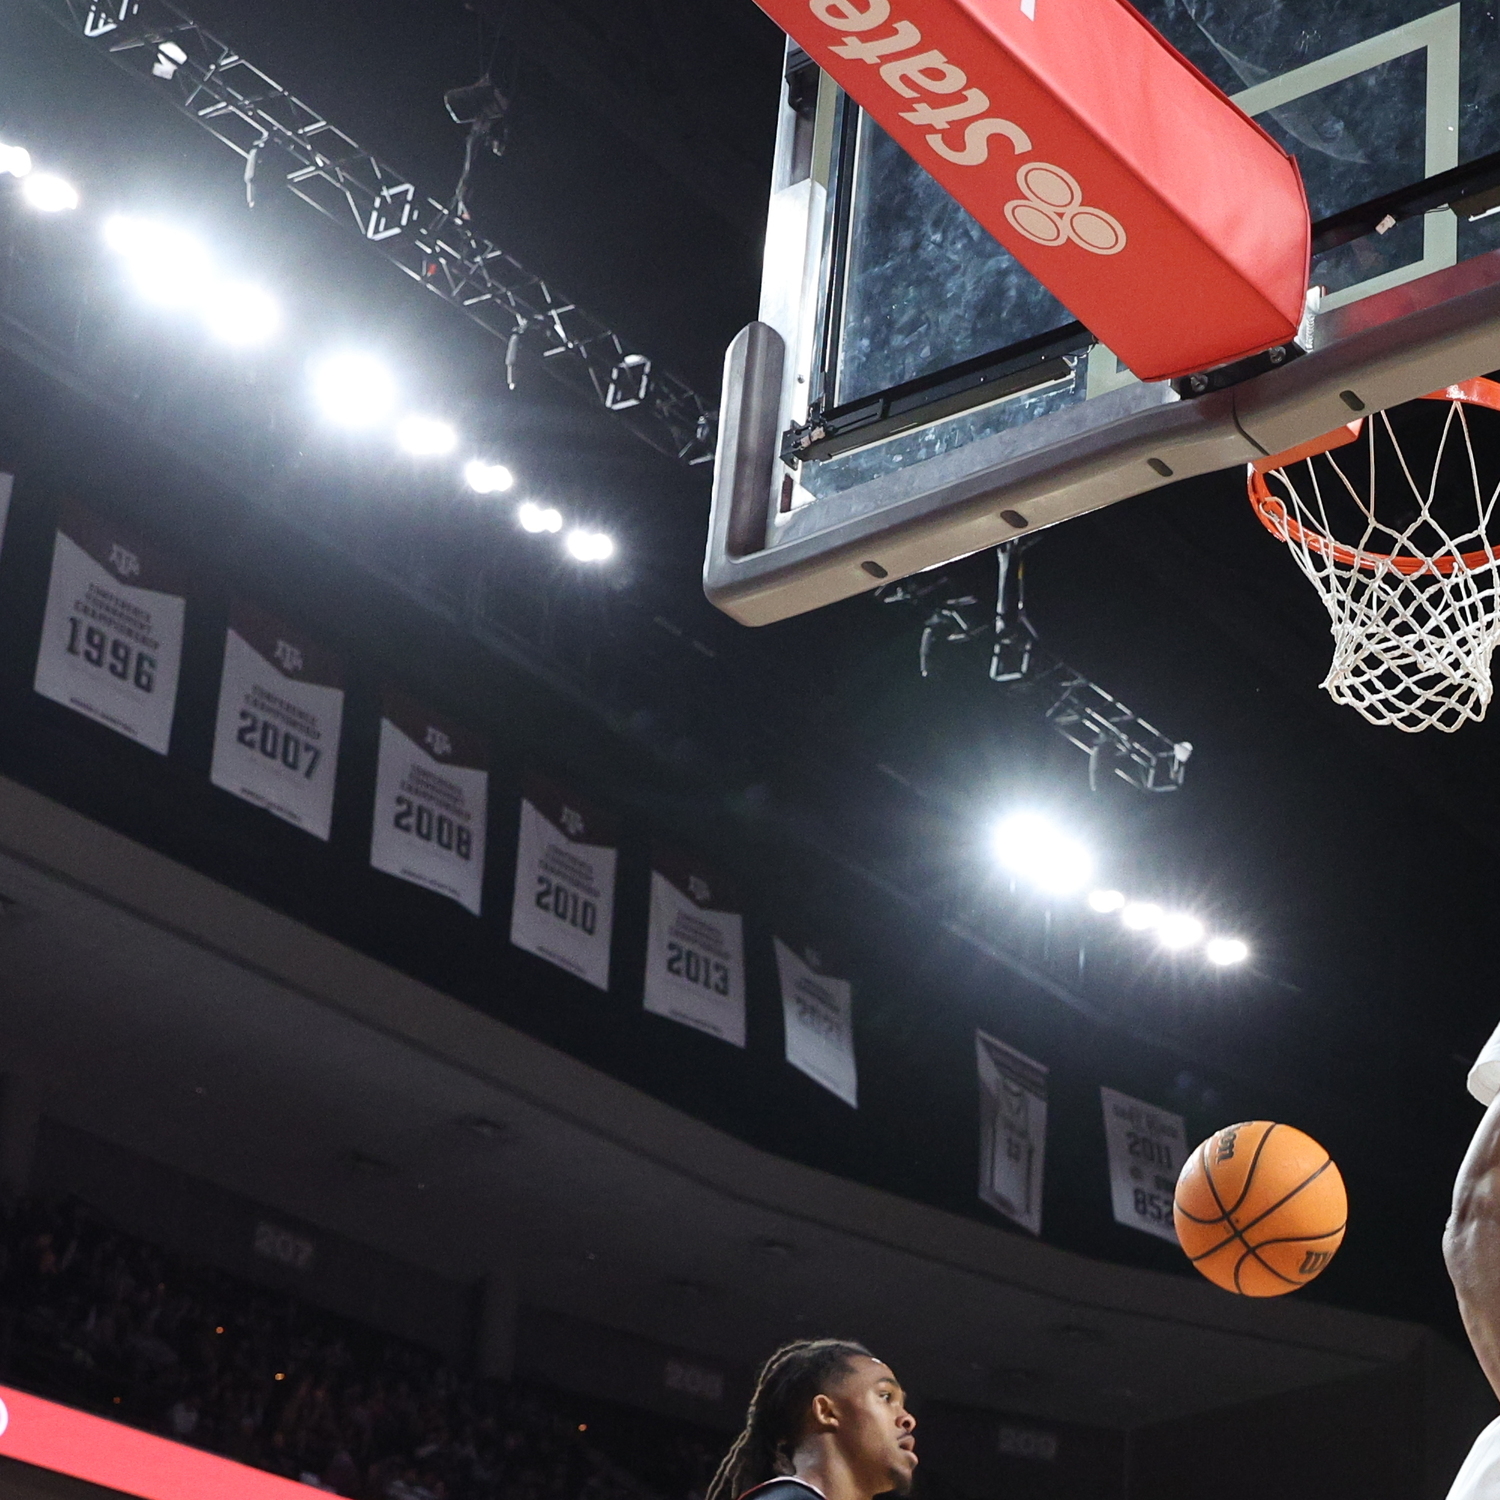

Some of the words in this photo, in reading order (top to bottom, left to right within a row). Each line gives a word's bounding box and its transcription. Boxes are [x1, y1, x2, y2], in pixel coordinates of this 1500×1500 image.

[809, 0, 1032, 166] State
[66, 616, 158, 693] 1996
[236, 709, 323, 781] 2007
[393, 794, 473, 861] 2008
[534, 875, 597, 936] 2010
[666, 942, 730, 997] 2013
